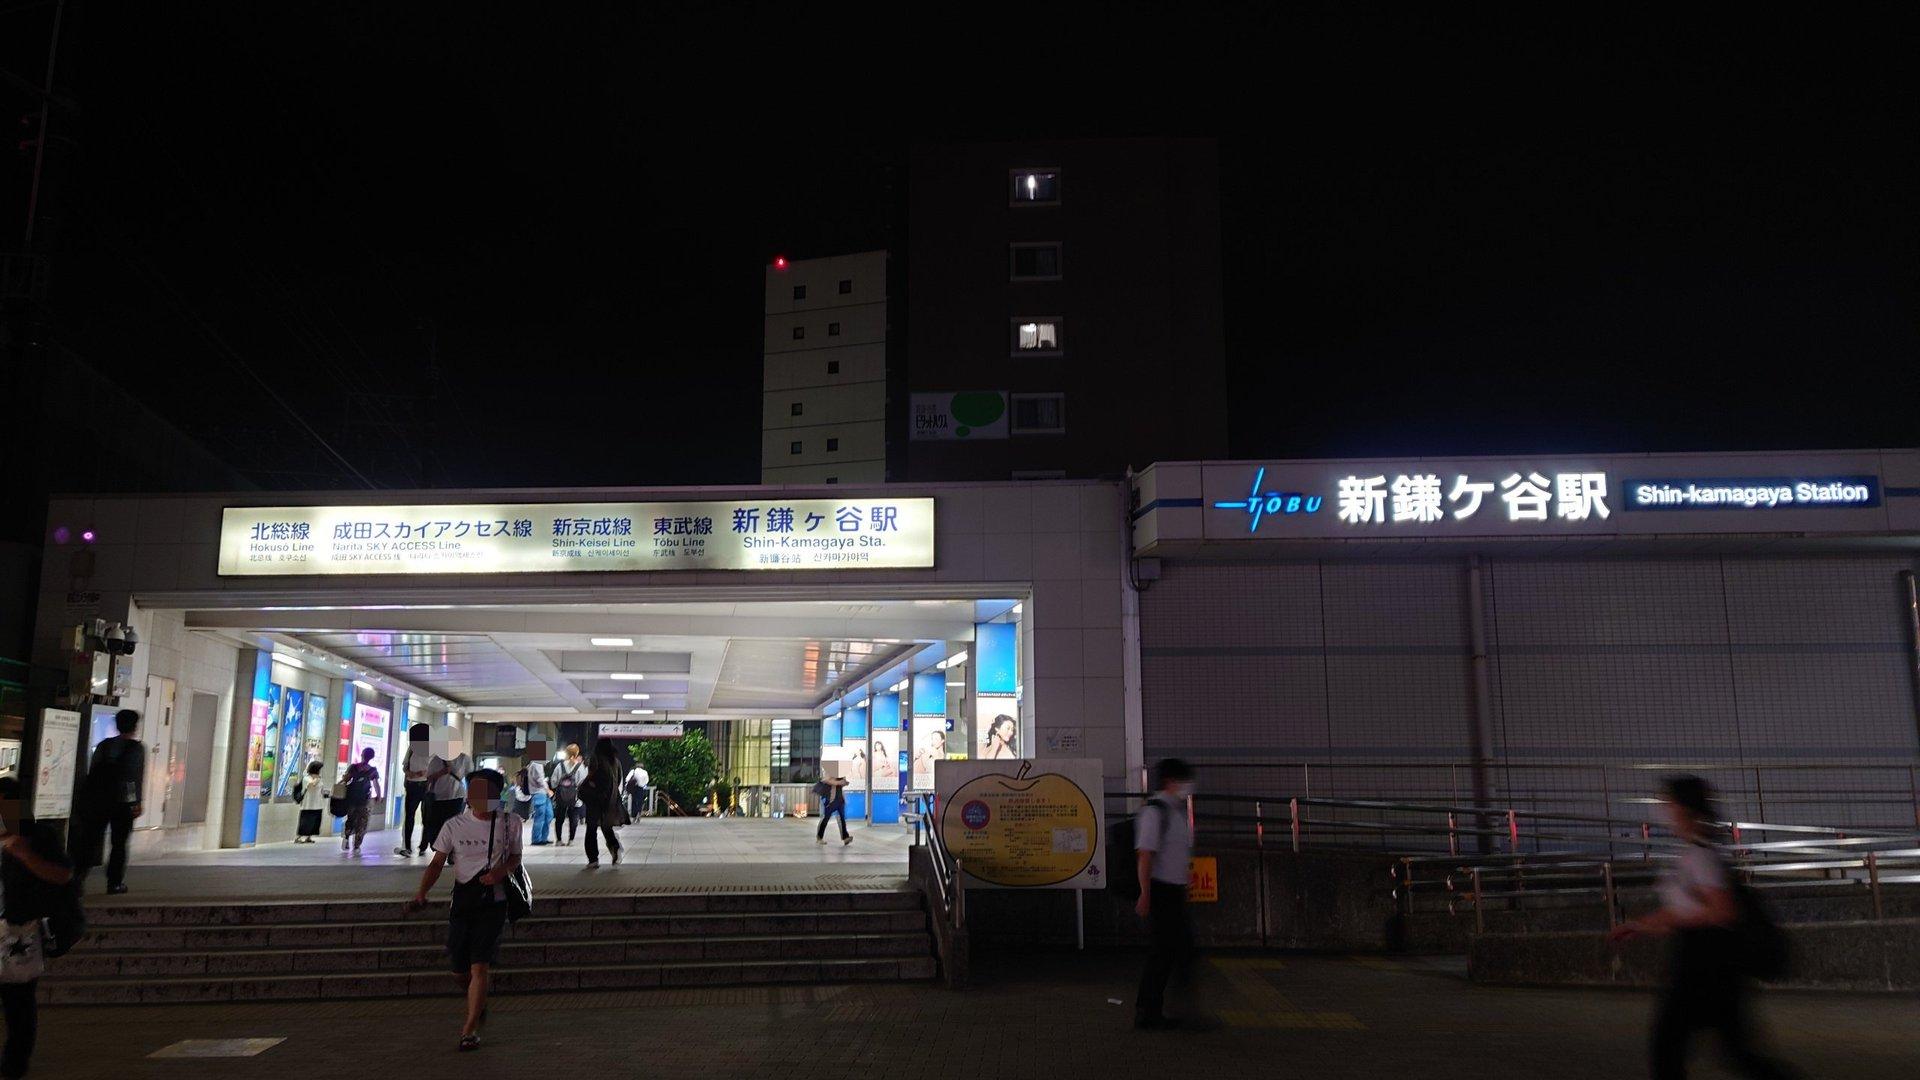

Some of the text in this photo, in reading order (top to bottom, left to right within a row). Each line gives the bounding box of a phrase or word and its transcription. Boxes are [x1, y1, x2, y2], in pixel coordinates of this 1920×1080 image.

[1338, 472, 1611, 523] 新鎌ケ谷駅
[1637, 482, 1869, 508] Shin-kamagaya Station
[1248, 496, 1322, 513] TOBU
[250, 521, 311, 541] 北総線
[333, 519, 532, 540] 成田スカイアクセス線
[552, 517, 632, 536] 新京成線
[653, 516, 713, 535] 東武線
[292, 542, 315, 552] Line
[332, 541, 461, 551] Narita SKY ACCESS Line
[552, 538, 636, 547] Shin-Keisei Line
[682, 537, 705, 547] Line
[743, 535, 886, 549] Shin-Kamagaya Sta.
[364, 553, 392, 561] ACCESS
